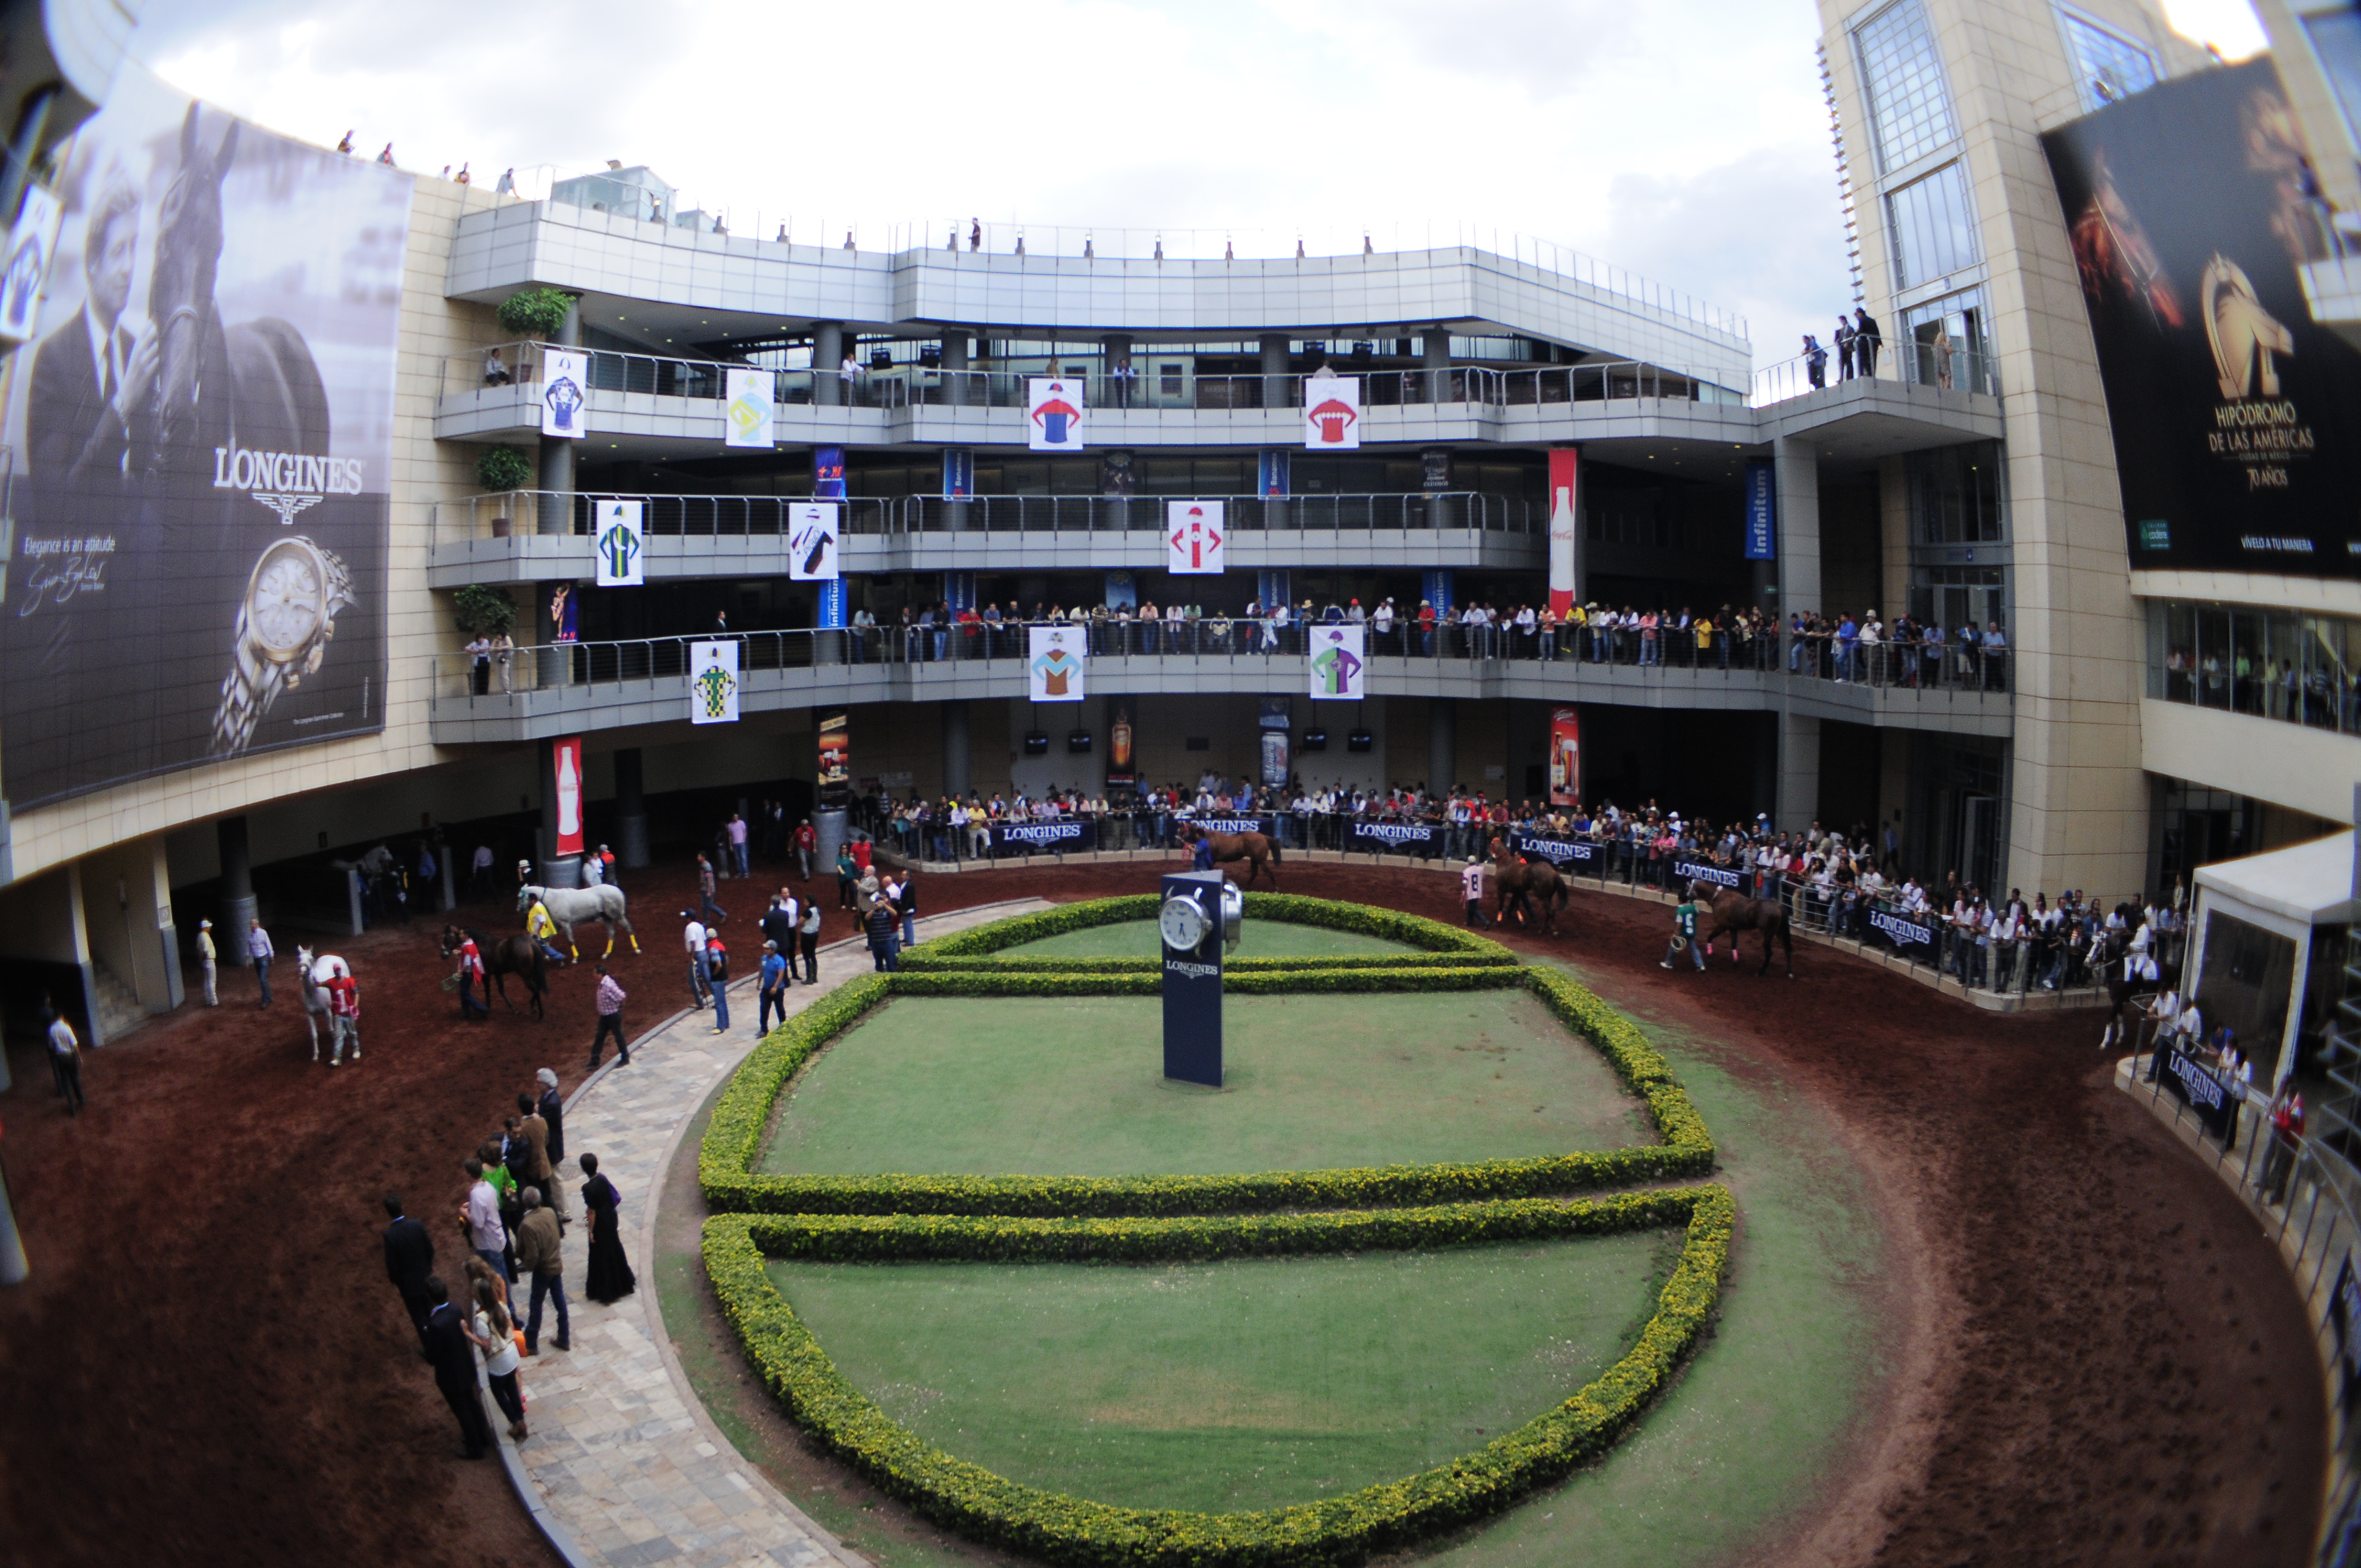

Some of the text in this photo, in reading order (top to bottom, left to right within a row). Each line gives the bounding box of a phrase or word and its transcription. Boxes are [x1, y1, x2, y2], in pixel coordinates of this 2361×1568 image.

[2215, 399, 2296, 428] HIPÓDROMO
[2208, 423, 2315, 452] DE LAS AMÉRICAS
[213, 447, 363, 496] LONGINES
[1754, 469, 1767, 553] infinitum
[1004, 825, 1081, 841] LONGINES
[1355, 824, 1430, 840] LONGINES
[1521, 838, 1591, 859] LONGINES
[1471, 874, 1478, 891] 8
[1674, 861, 1739, 887] LONGINES
[1870, 910, 1931, 944] LONGINES
[1166, 960, 1218, 976] LONGINES
[336, 989, 348, 1012] 1
[2169, 1050, 2223, 1109] LONGINES
